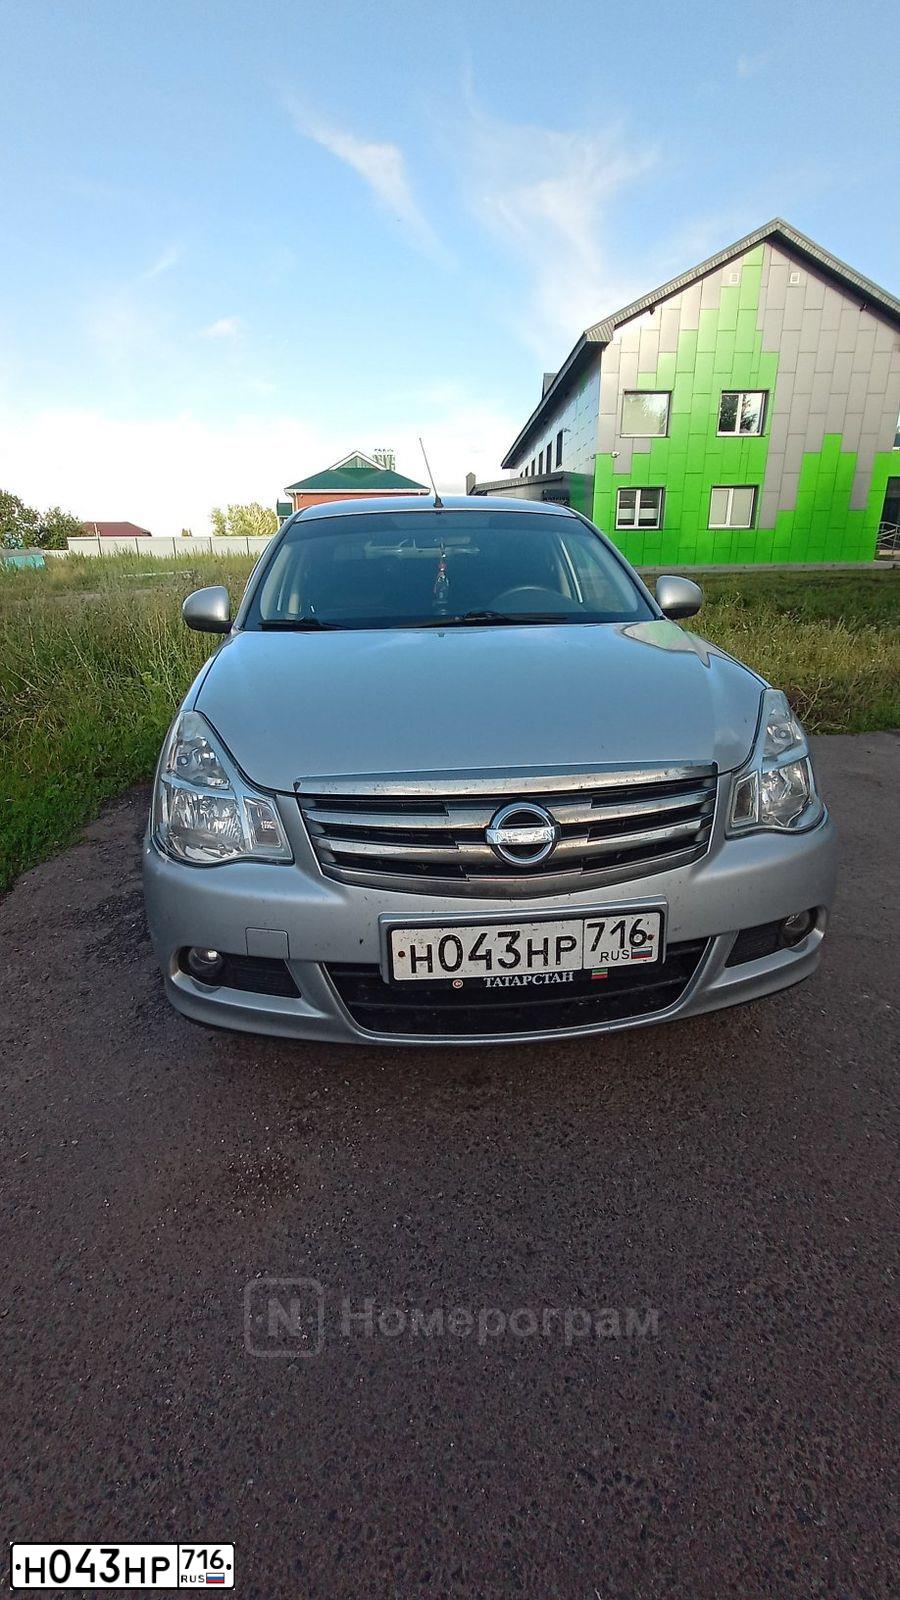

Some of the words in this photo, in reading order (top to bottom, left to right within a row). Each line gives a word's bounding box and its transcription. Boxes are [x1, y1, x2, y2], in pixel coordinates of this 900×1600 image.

[586, 918, 648, 952] 716
[599, 949, 630, 963] RUS
[483, 971, 574, 988] ТАТАРСТАН
